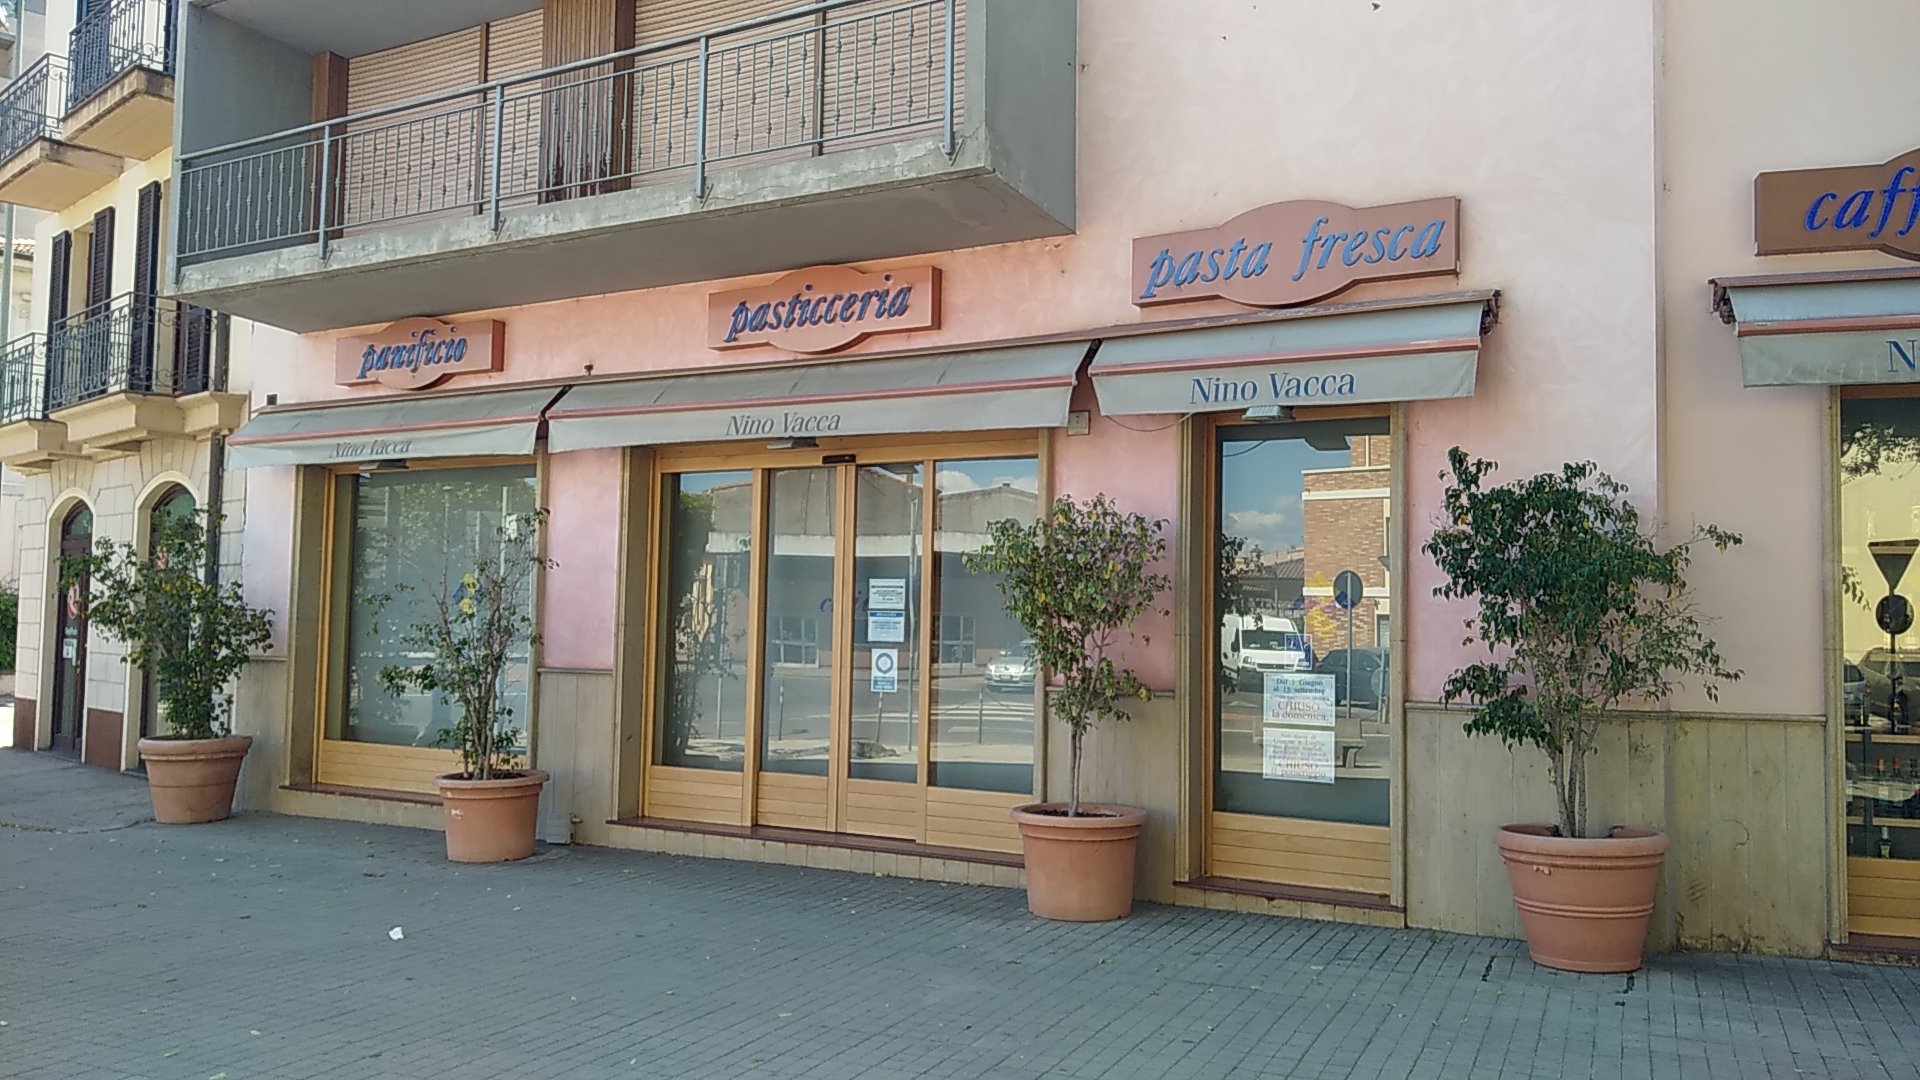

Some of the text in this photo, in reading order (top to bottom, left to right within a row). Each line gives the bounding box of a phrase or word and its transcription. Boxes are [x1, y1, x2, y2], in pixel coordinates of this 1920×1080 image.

[1139, 216, 1446, 299] pasta fresca
[723, 274, 913, 343] pasticceria
[356, 326, 468, 379] panificio
[1190, 372, 1357, 405] Nino Vacca
[725, 412, 841, 436] Nino Vacca
[328, 438, 412, 459] Nino Vacca
[1271, 709, 1280, 718] la
[1278, 700, 1320, 712] CHIUSO
